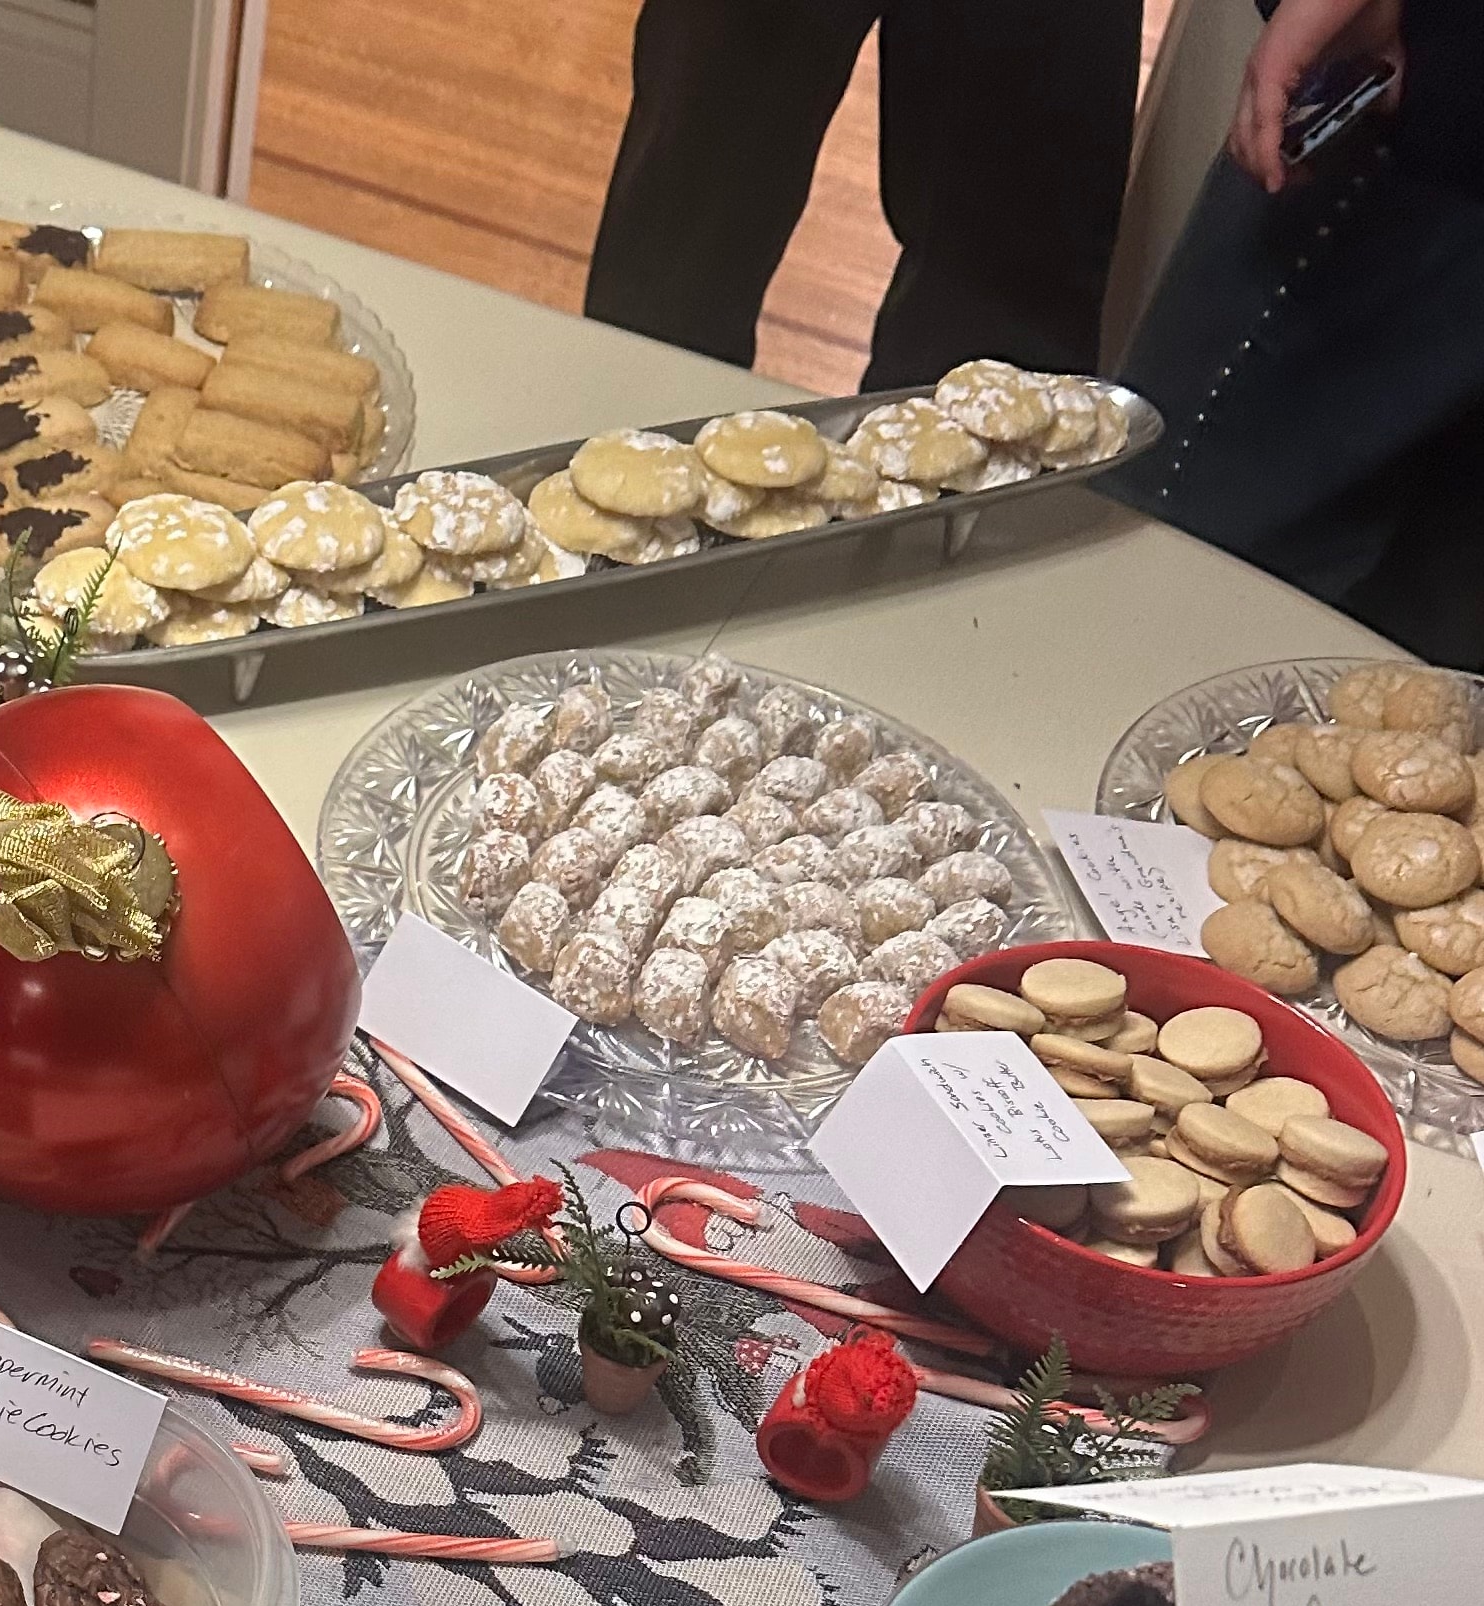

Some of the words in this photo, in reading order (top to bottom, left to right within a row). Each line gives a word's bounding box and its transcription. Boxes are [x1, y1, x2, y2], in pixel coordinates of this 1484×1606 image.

[920, 1058, 970, 1112] Sandwich
[981, 1076, 1024, 1118] Biscoff
[971, 1090, 1012, 1136] Cookies
[1033, 1100, 1071, 1143] Cookie
[972, 1121, 1008, 1159] Linzer
[1029, 1128, 1063, 1161] Lotus
[23, 1412, 123, 1468] Cookies
